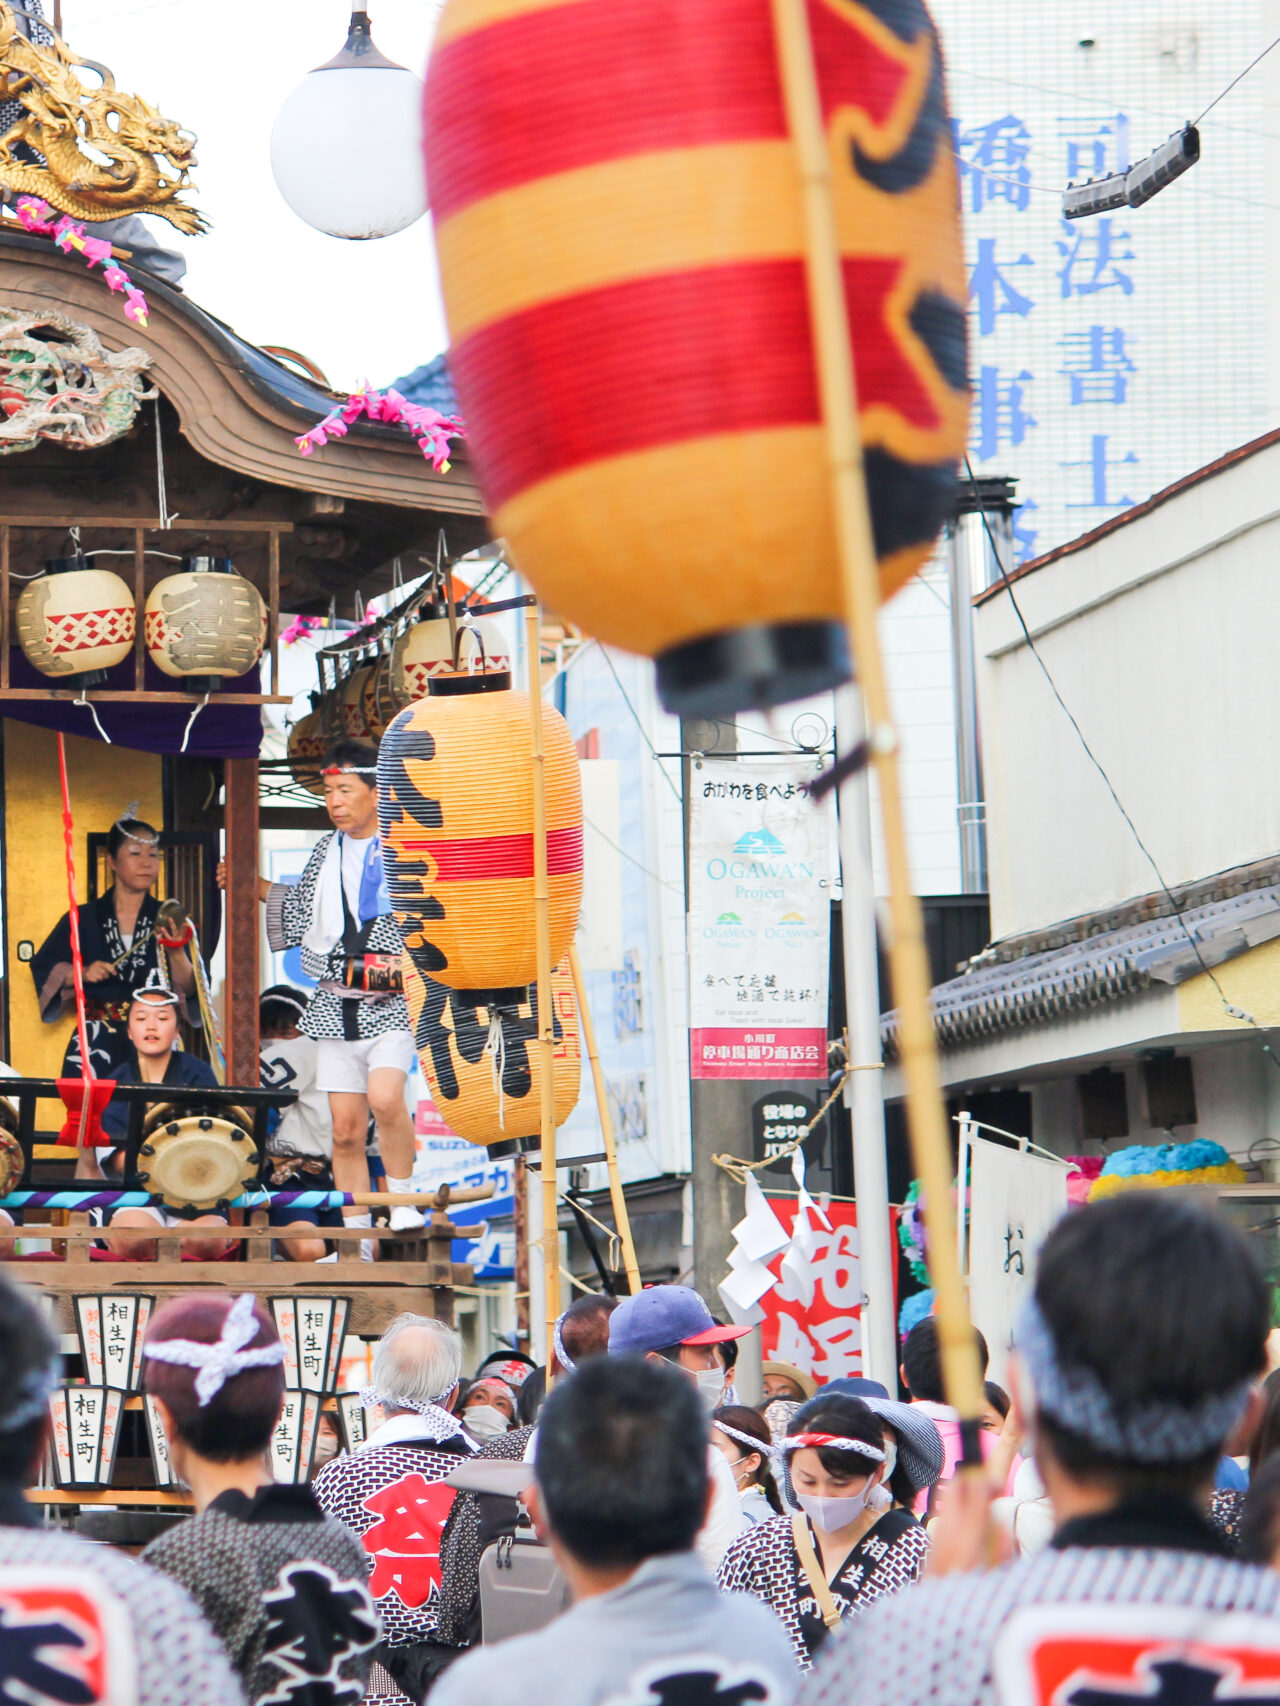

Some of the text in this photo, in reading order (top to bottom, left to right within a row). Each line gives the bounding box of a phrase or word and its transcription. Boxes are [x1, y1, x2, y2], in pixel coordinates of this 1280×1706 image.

[1054, 112, 1141, 507] 司法書士
[953, 114, 1038, 562] 橋本事
[706, 858, 815, 880] OGAWA'N
[734, 885, 786, 900] Project
[703, 1045, 819, 1060] 停車場通り商店会
[428, 1140, 483, 1151] SUZU
[106, 1302, 128, 1363] 相生町
[303, 1309, 324, 1377] 相生町
[73, 1393, 96, 1464] 相生町
[349, 1405, 366, 1442] 相生
